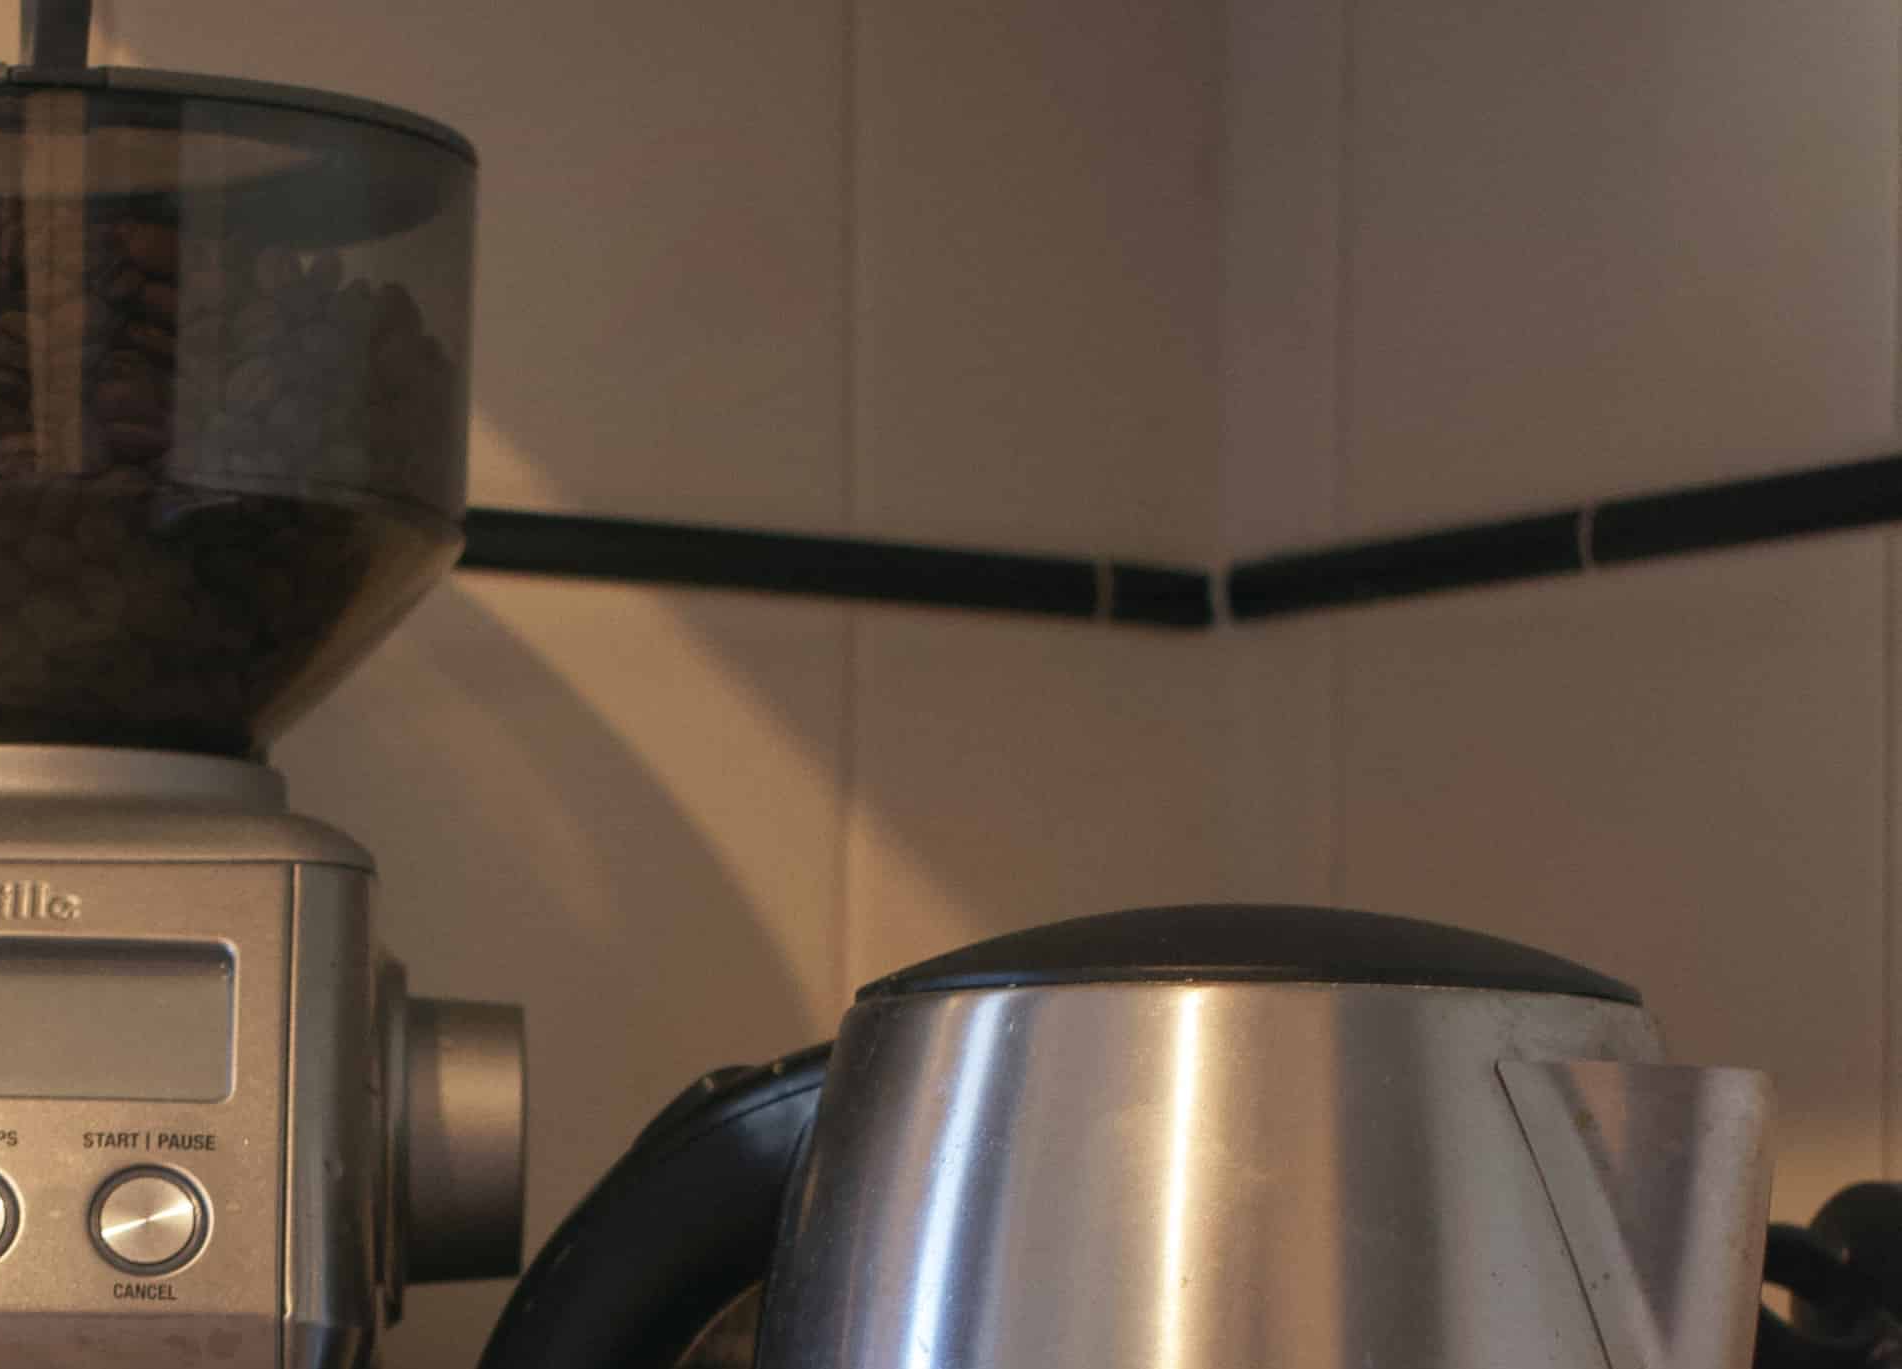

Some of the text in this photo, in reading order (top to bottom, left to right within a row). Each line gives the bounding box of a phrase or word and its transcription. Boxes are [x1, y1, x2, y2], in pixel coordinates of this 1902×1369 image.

[82, 1132, 217, 1152] START PAUSE
[112, 1283, 177, 1301] CANCEL
